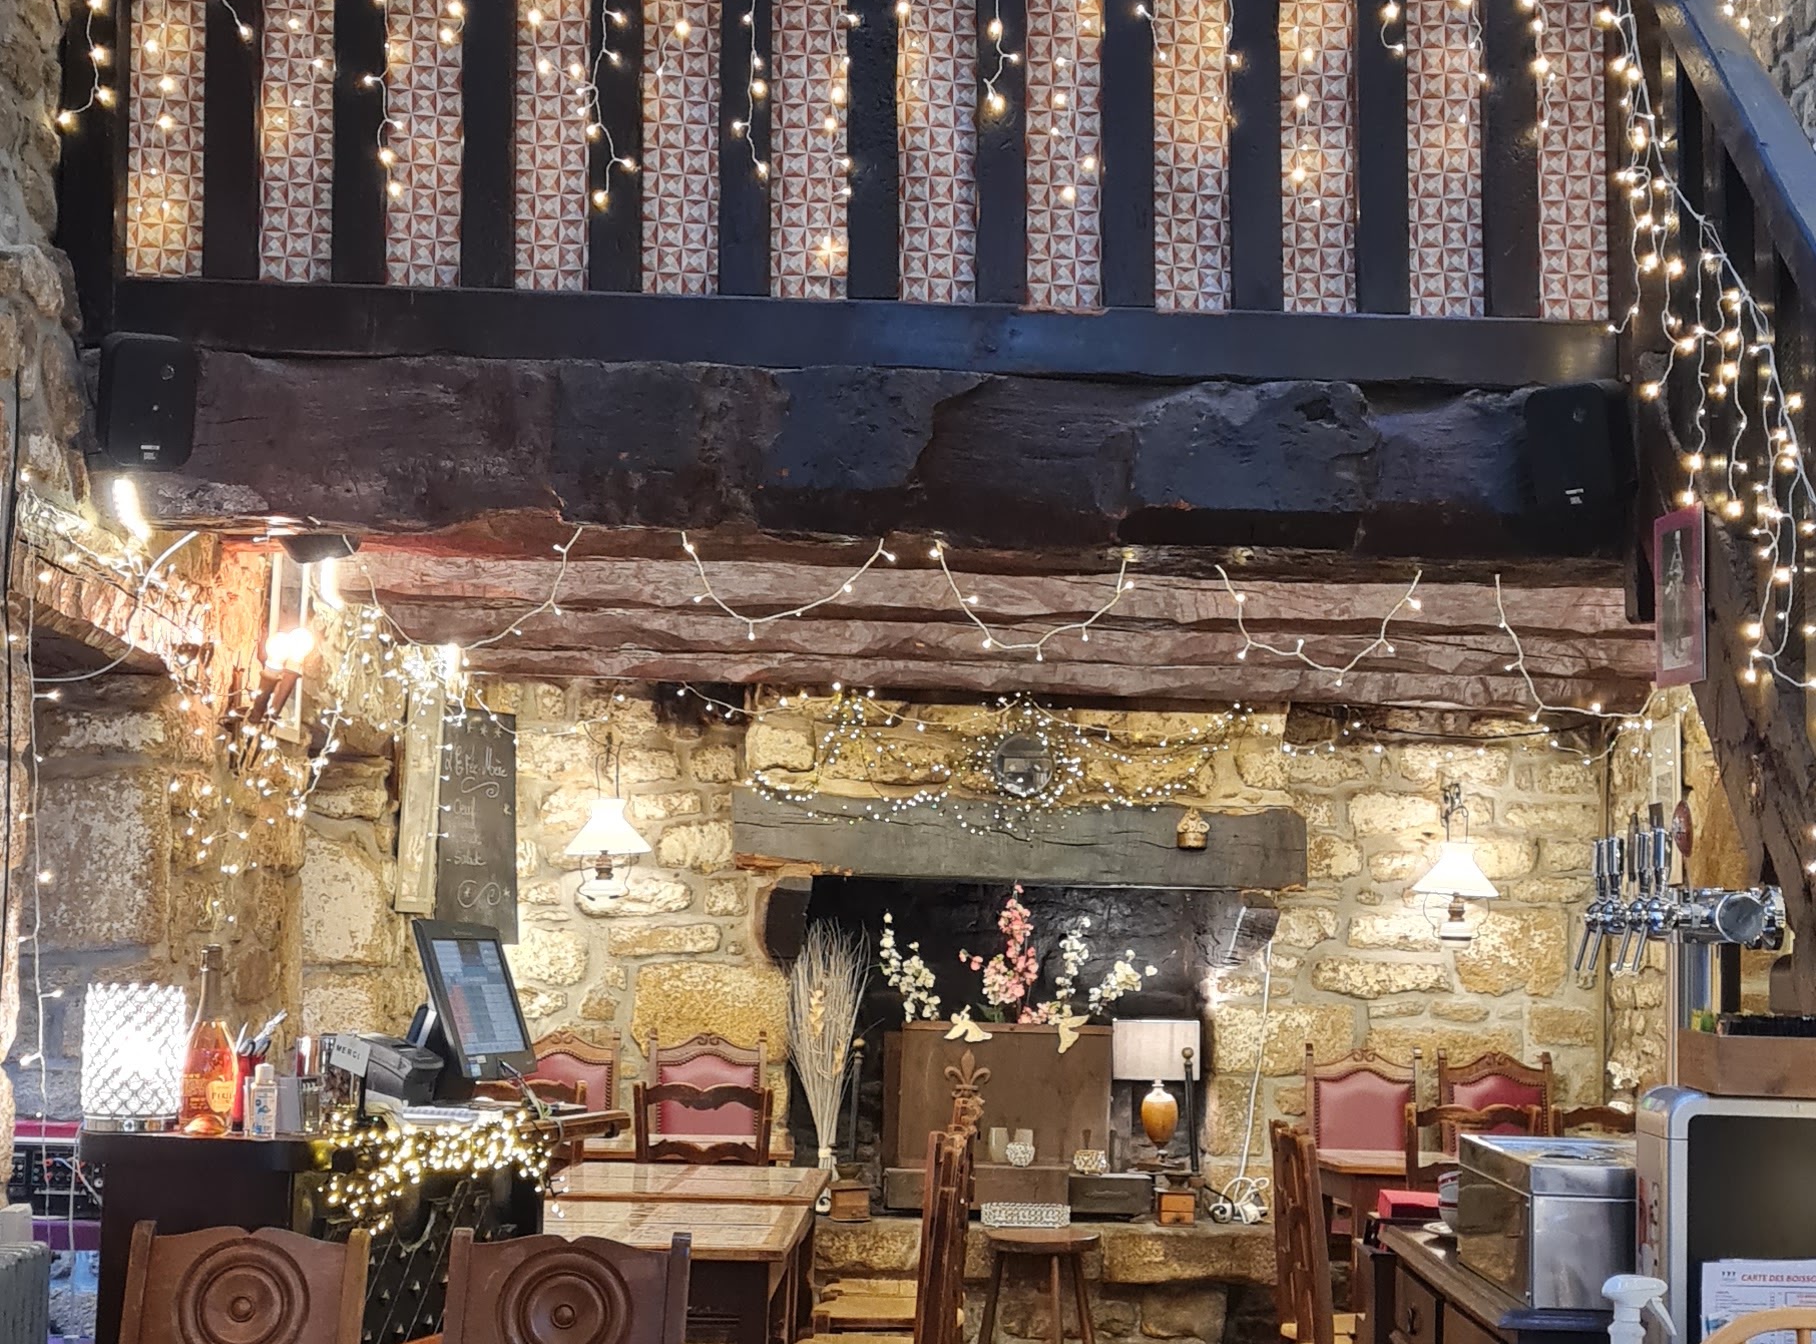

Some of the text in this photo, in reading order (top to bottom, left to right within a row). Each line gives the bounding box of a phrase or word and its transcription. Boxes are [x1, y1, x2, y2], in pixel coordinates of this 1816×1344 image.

[336, 1044, 360, 1060] MERCI
[1741, 1273, 1767, 1282] CARTE
[1768, 1274, 1785, 1283] DES
